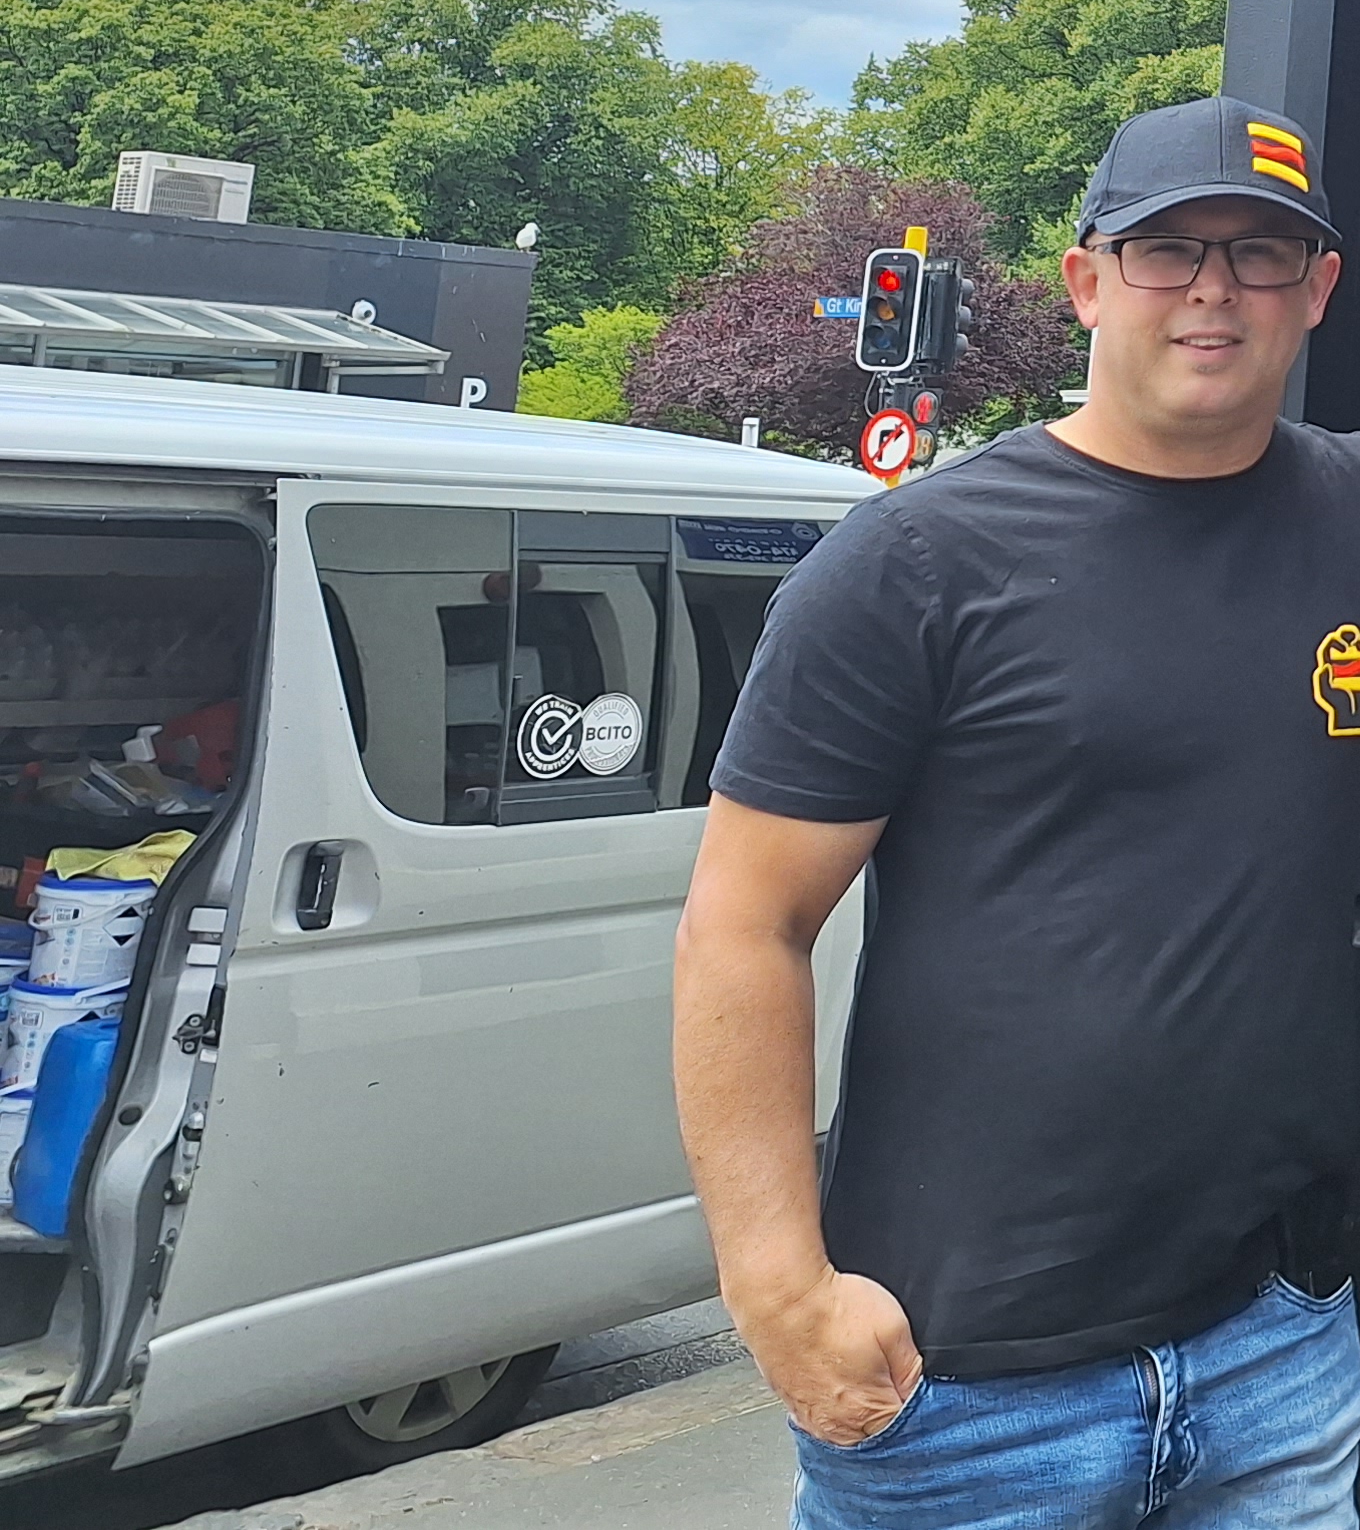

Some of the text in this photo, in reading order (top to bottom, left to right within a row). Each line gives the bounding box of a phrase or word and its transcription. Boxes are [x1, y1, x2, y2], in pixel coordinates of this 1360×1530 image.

[827, 298, 863, 313] Gt Kin
[461, 377, 487, 408] P
[549, 700, 575, 716] TRAIN
[592, 701, 630, 718] QUALIFIED
[585, 725, 632, 741] BCITO
